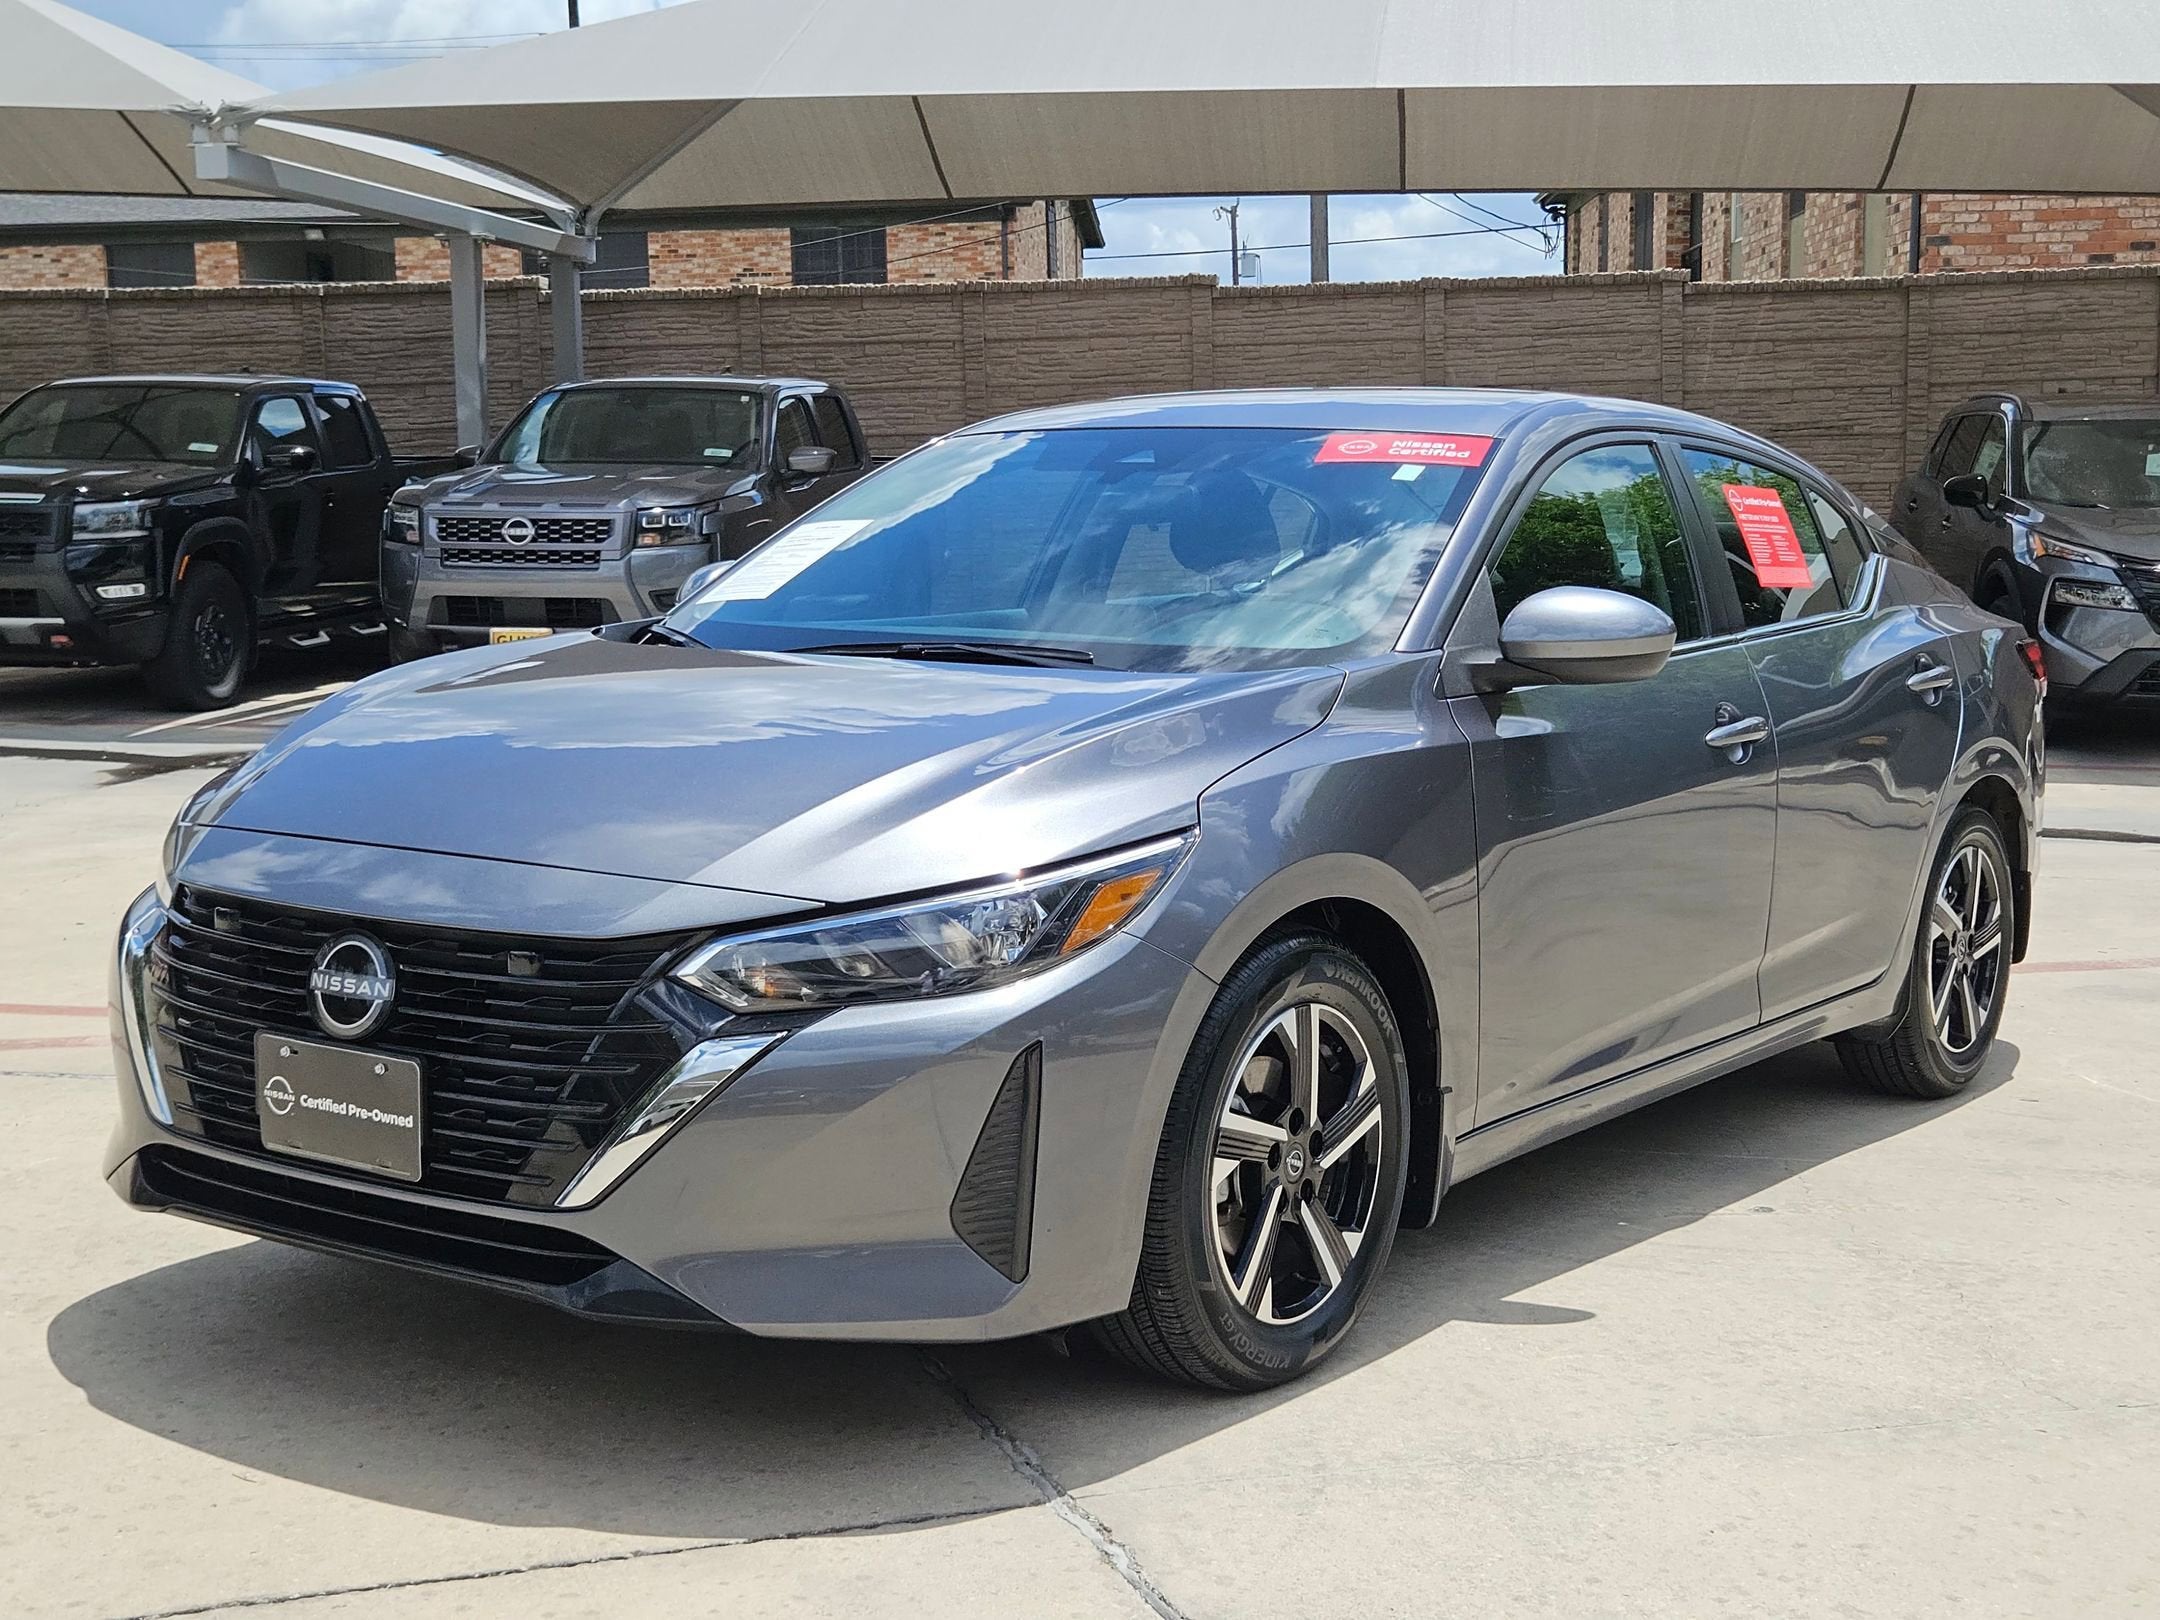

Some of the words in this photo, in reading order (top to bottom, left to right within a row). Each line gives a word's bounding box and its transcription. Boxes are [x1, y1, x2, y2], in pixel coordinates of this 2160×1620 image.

[1391, 440, 1457, 450] Nissan
[1388, 447, 1471, 459] Certified
[312, 972, 390, 997] NISSAN
[263, 1089, 296, 1101] NISSAN
[299, 1094, 347, 1116] Certified
[347, 1104, 414, 1128] Pre-Owned
